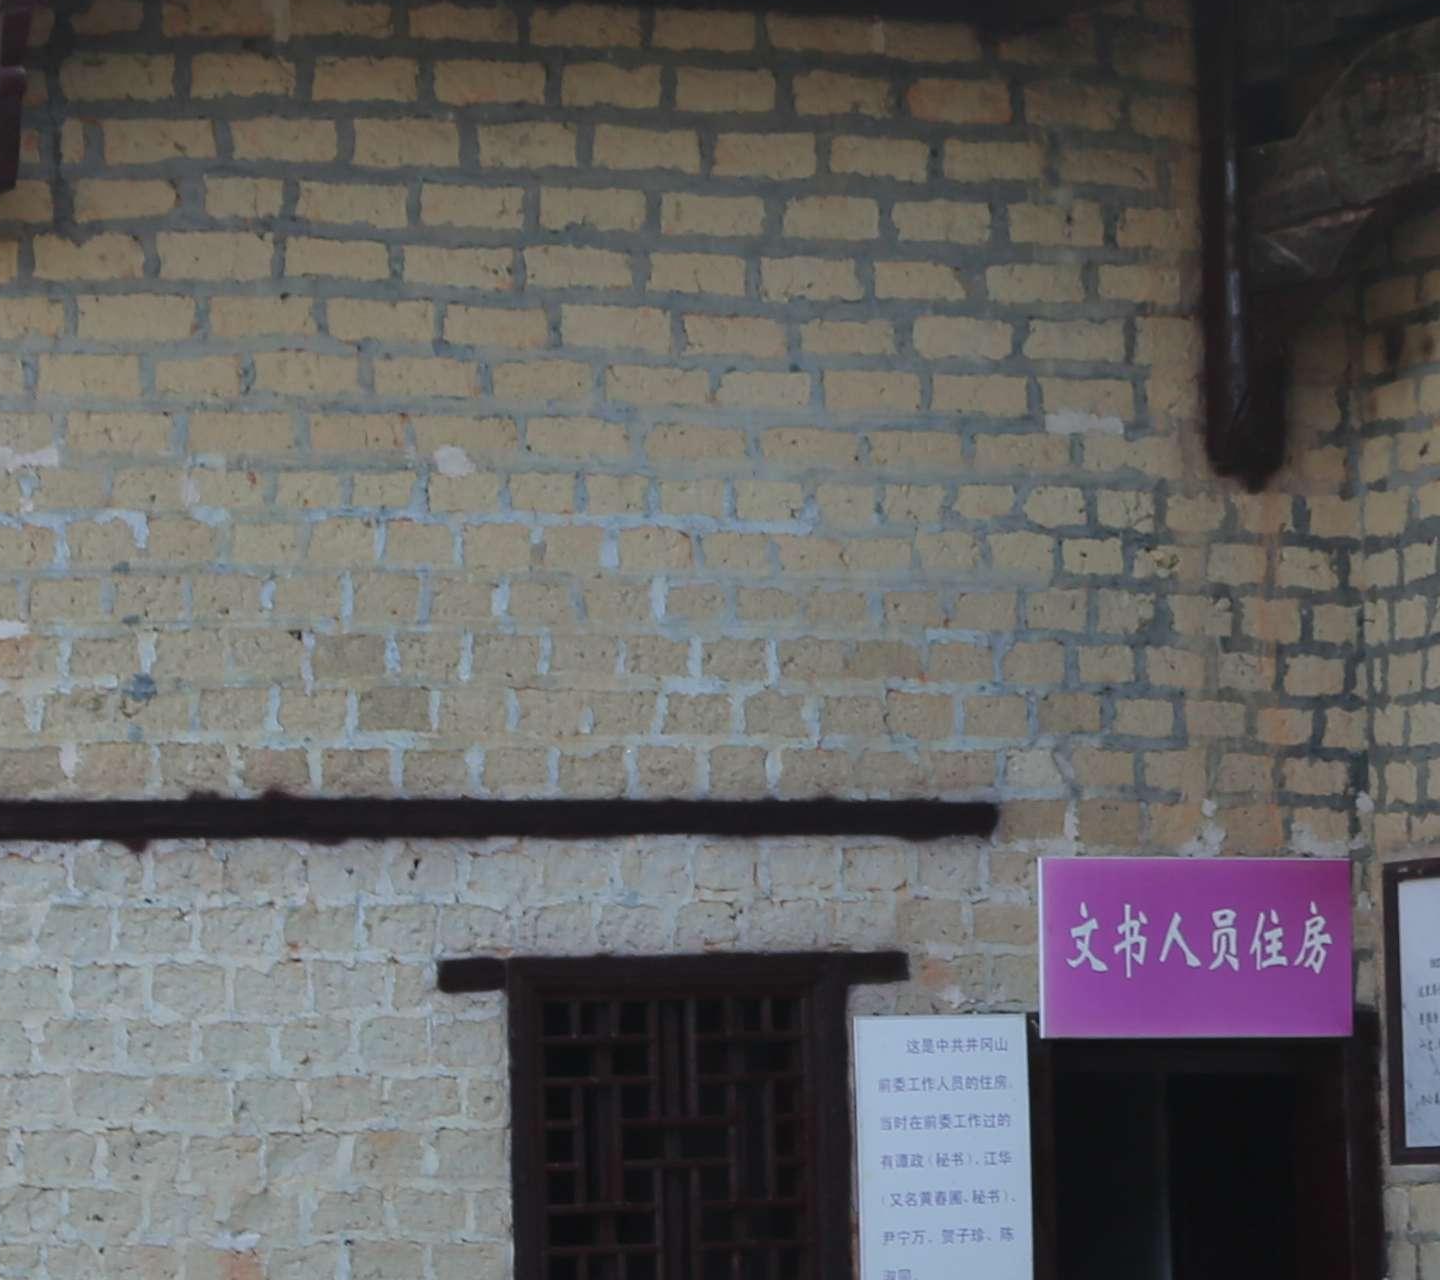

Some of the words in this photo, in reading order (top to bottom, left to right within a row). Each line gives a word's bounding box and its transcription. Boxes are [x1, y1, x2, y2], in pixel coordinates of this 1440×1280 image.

[1066, 900, 1333, 979] 文书人员住房
[906, 1037, 1009, 1054] 这是中共井冈山
[880, 1113, 1012, 1131] 当时在前委工作过的
